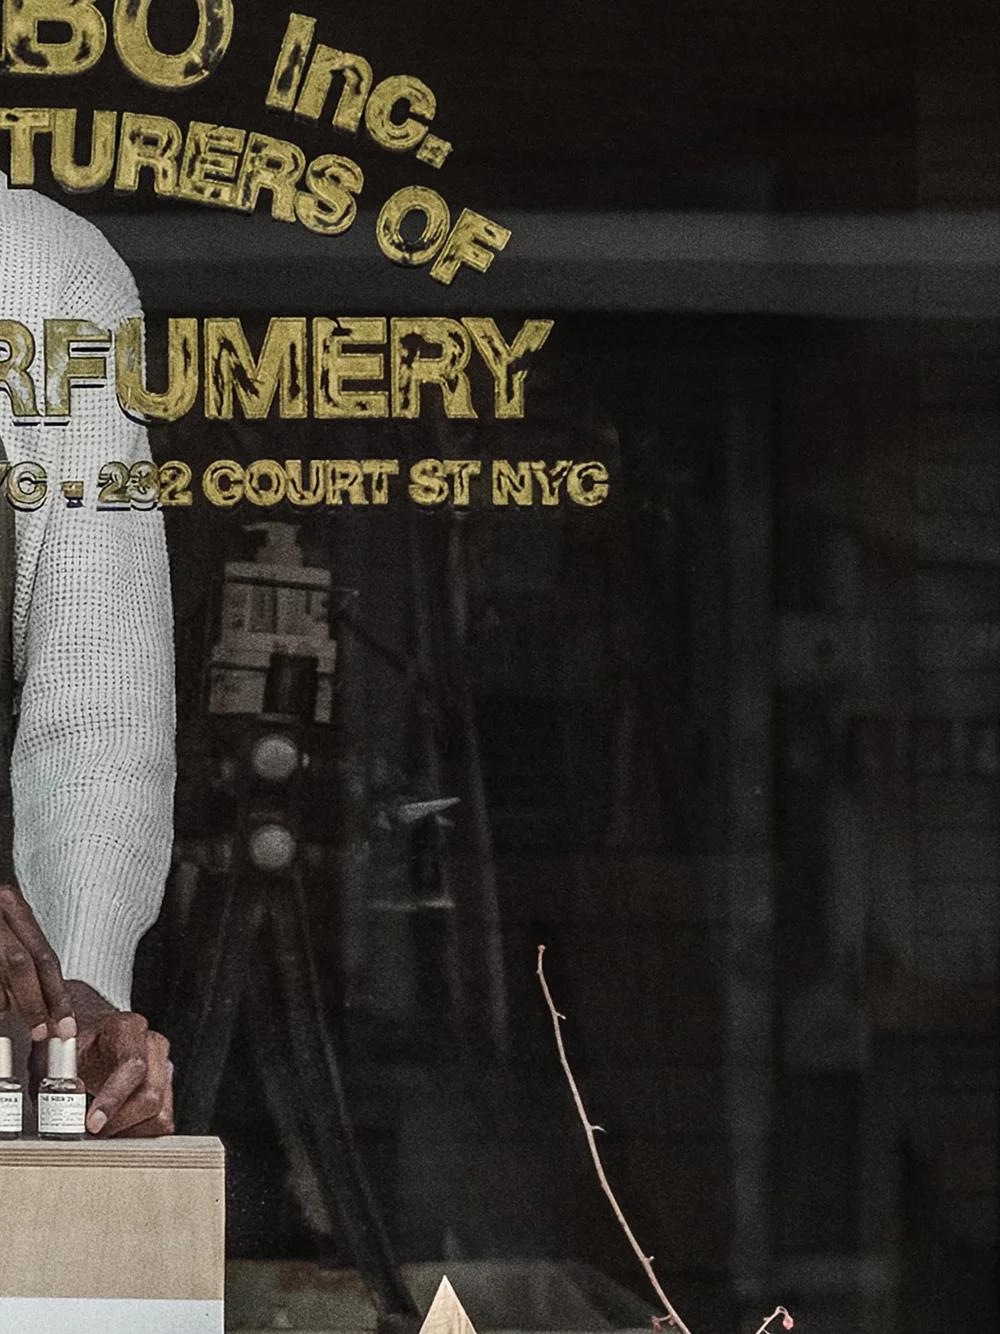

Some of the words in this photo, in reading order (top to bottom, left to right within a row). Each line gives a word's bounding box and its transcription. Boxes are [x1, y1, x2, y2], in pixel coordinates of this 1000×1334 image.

[265, 12, 454, 168] Inc.
[376, 185, 511, 284] OF
[97, 461, 192, 508] 232
[202, 460, 399, 507] COURT
[408, 460, 479, 507] ST
[491, 460, 609, 508] NYC
